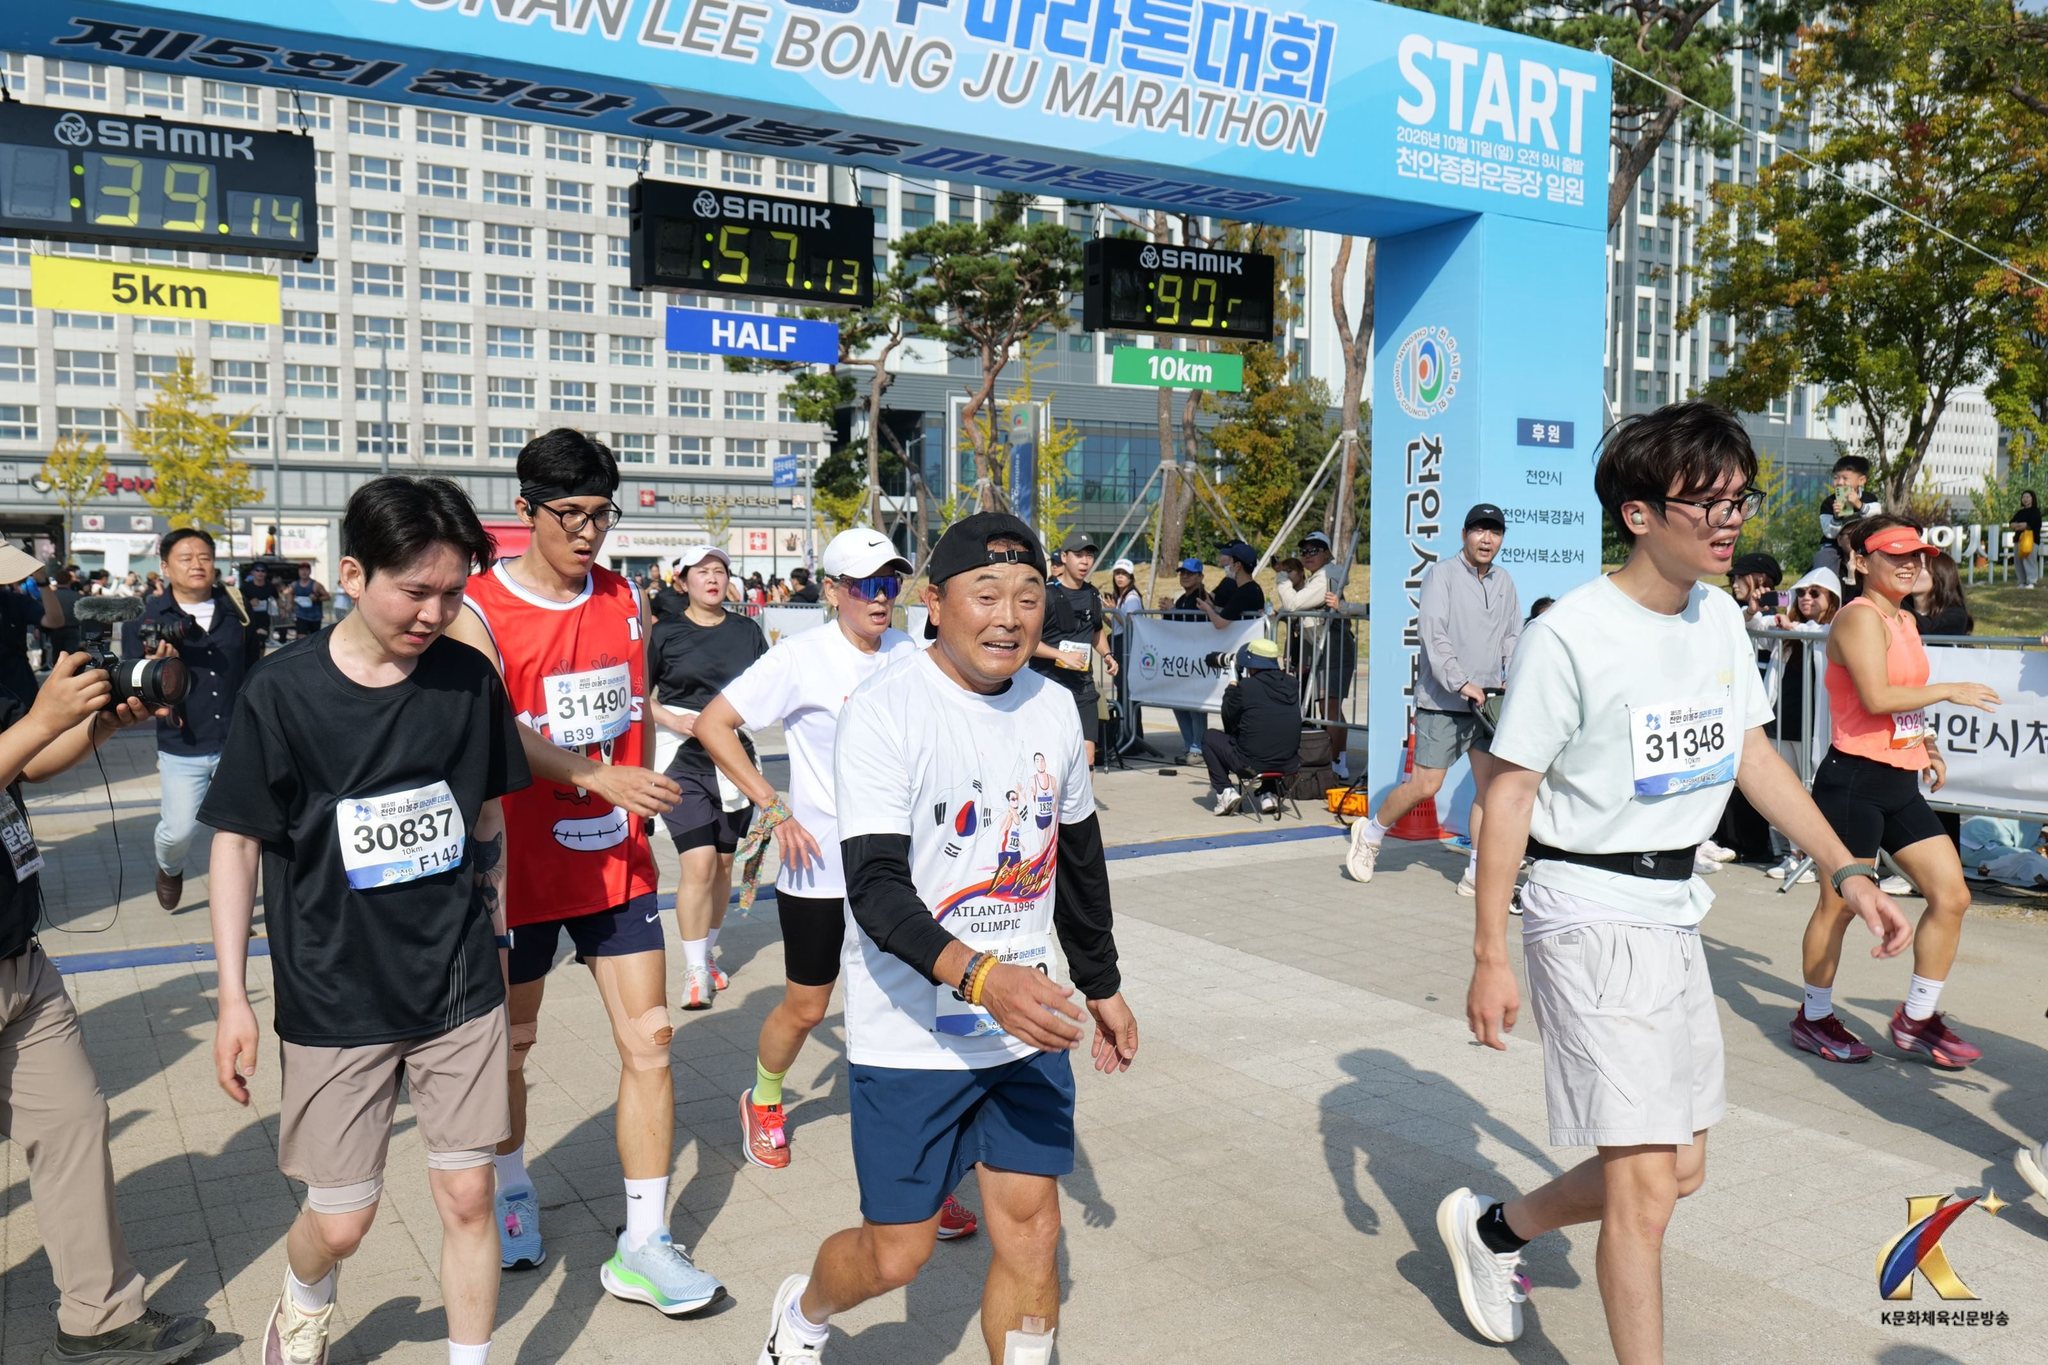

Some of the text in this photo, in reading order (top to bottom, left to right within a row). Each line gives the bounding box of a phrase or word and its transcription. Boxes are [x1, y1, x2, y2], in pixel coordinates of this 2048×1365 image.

[643, 0, 768, 59] LEE
[775, 15, 952, 89] BONG
[963, 53, 1039, 105] JU
[1044, 65, 1325, 154] MARATHON
[1396, 33, 1597, 155] START
[55, 18, 1298, 212] 제5회 천안 이봉주 마라톤대회
[97, 120, 255, 161] SAMIK
[1396, 125, 1440, 148] 2026년
[1443, 134, 1468, 154] 10월
[1518, 149, 1540, 167] 오전
[1542, 154, 1560, 171] 9시
[1562, 157, 1584, 175] 출발
[1396, 146, 1584, 206] 천안종합운동장 일원
[722, 196, 831, 230] SAMIK
[1162, 249, 1243, 275] SAMIK
[111, 272, 208, 310] 5km
[711, 318, 797, 352] HALF
[1148, 355, 1213, 384] 10km
[1531, 423, 1561, 444] 후원
[1525, 469, 1562, 486] 천안시
[1502, 508, 1585, 526] 천안서북경찰서
[1500, 548, 1585, 565] 천안서북소방서
[558, 686, 627, 720] 31490
[563, 727, 594, 743] B39
[1645, 722, 1725, 763] 31348
[397, 803, 419, 814] 이봉주
[353, 807, 453, 854] 30837
[402, 845, 423, 856] 10km
[418, 843, 459, 872] F142
[952, 900, 1035, 917] ATLANTA 1996
[970, 918, 1021, 933] OLIMPIC
